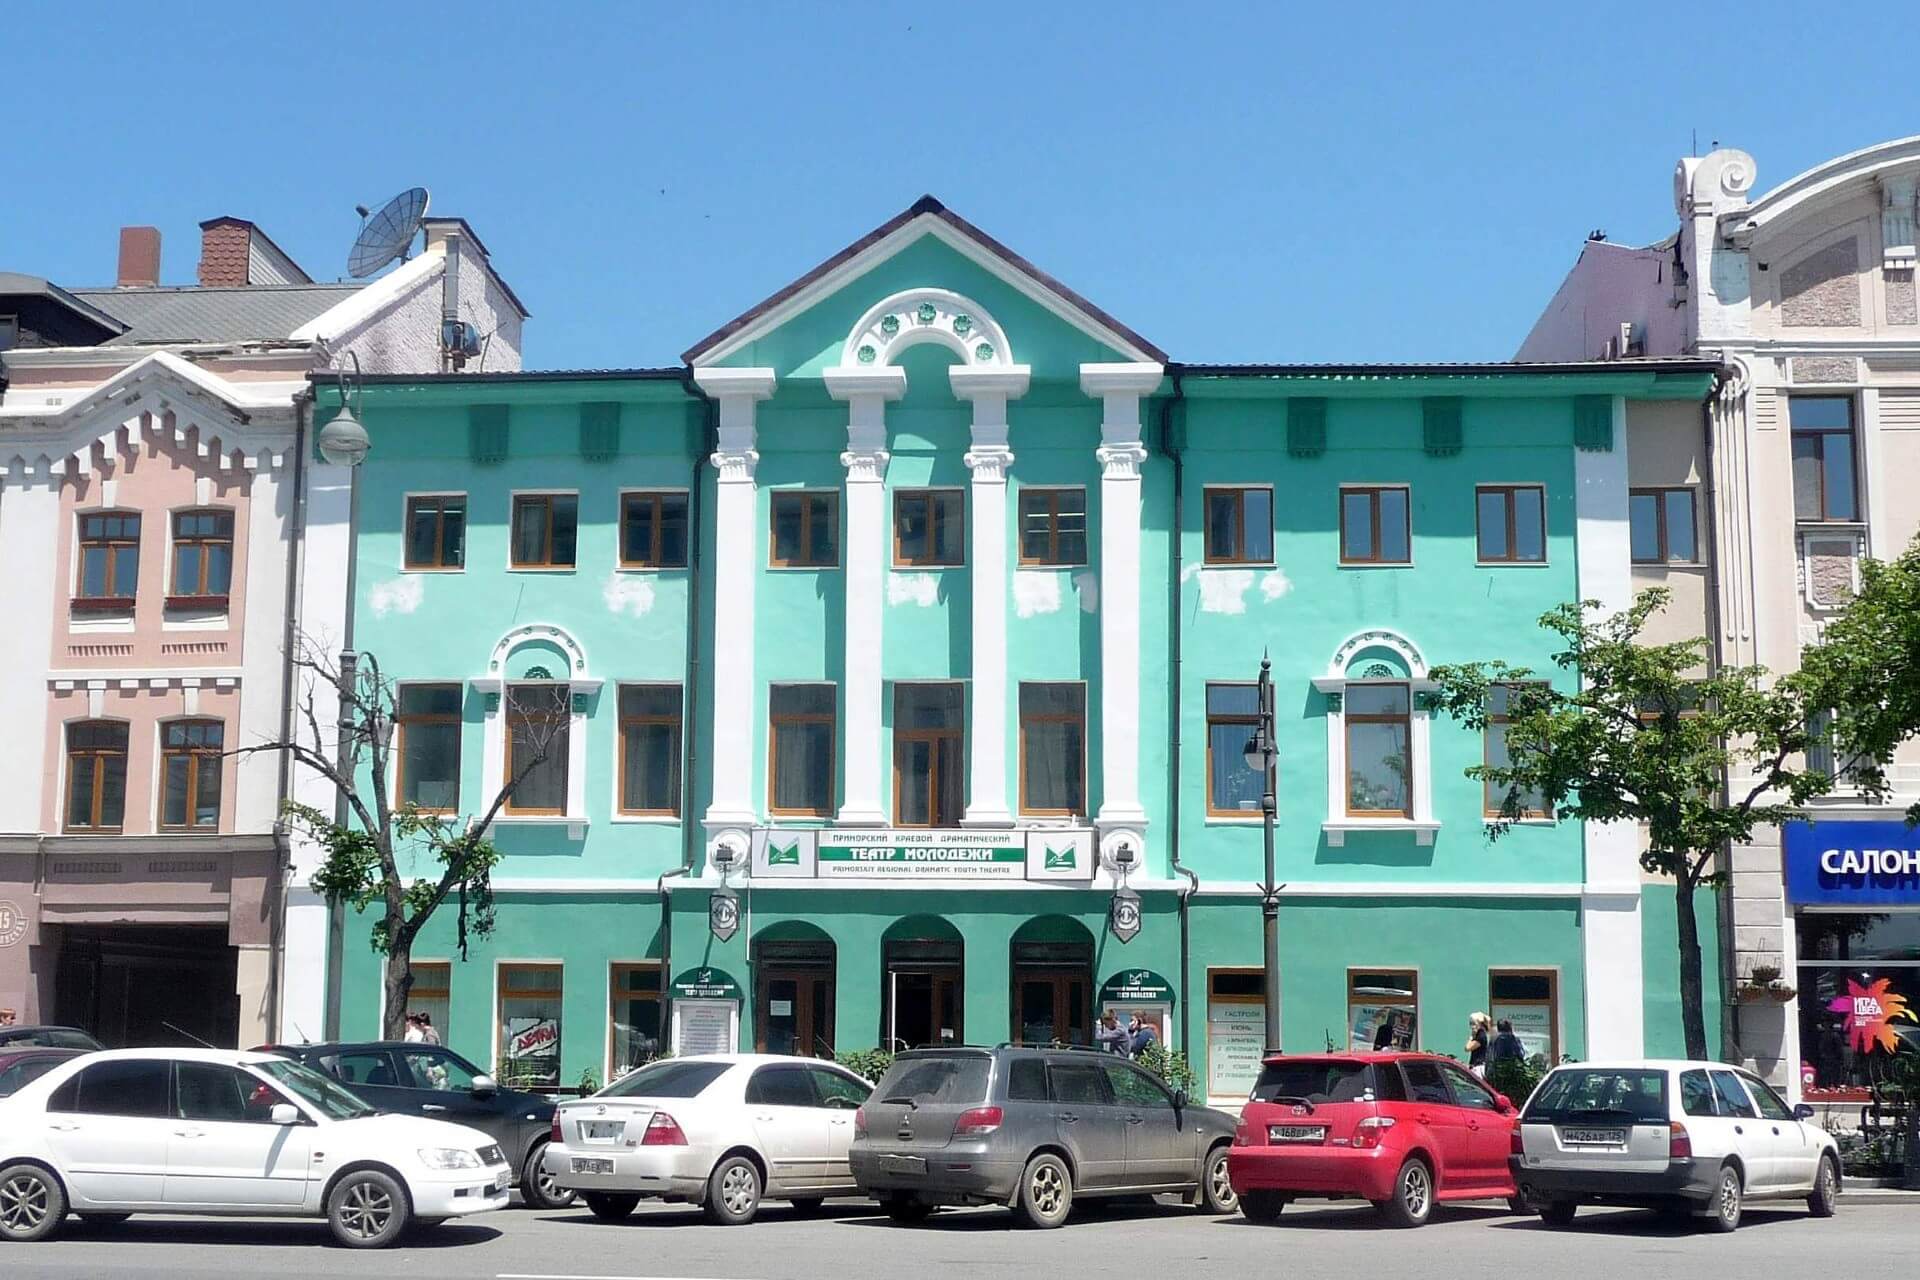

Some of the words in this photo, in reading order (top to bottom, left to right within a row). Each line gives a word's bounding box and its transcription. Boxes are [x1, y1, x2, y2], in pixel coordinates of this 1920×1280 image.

[833, 833, 888, 843] ПРИМОРСКИЙ
[895, 833, 933, 843] КРАЕВОЙ
[940, 833, 1011, 844] ДРАМАТИЧЕСКИЙ
[849, 847, 896, 861] ТЕАТР
[904, 847, 993, 861] МОЛОДЕЖИ
[877, 865, 911, 873] REGIONAL
[915, 865, 951, 874] DRAMATIC
[954, 866, 977, 874] YOUTH
[980, 866, 1011, 874] THEATRE
[1853, 996, 1879, 1007] ИГРА
